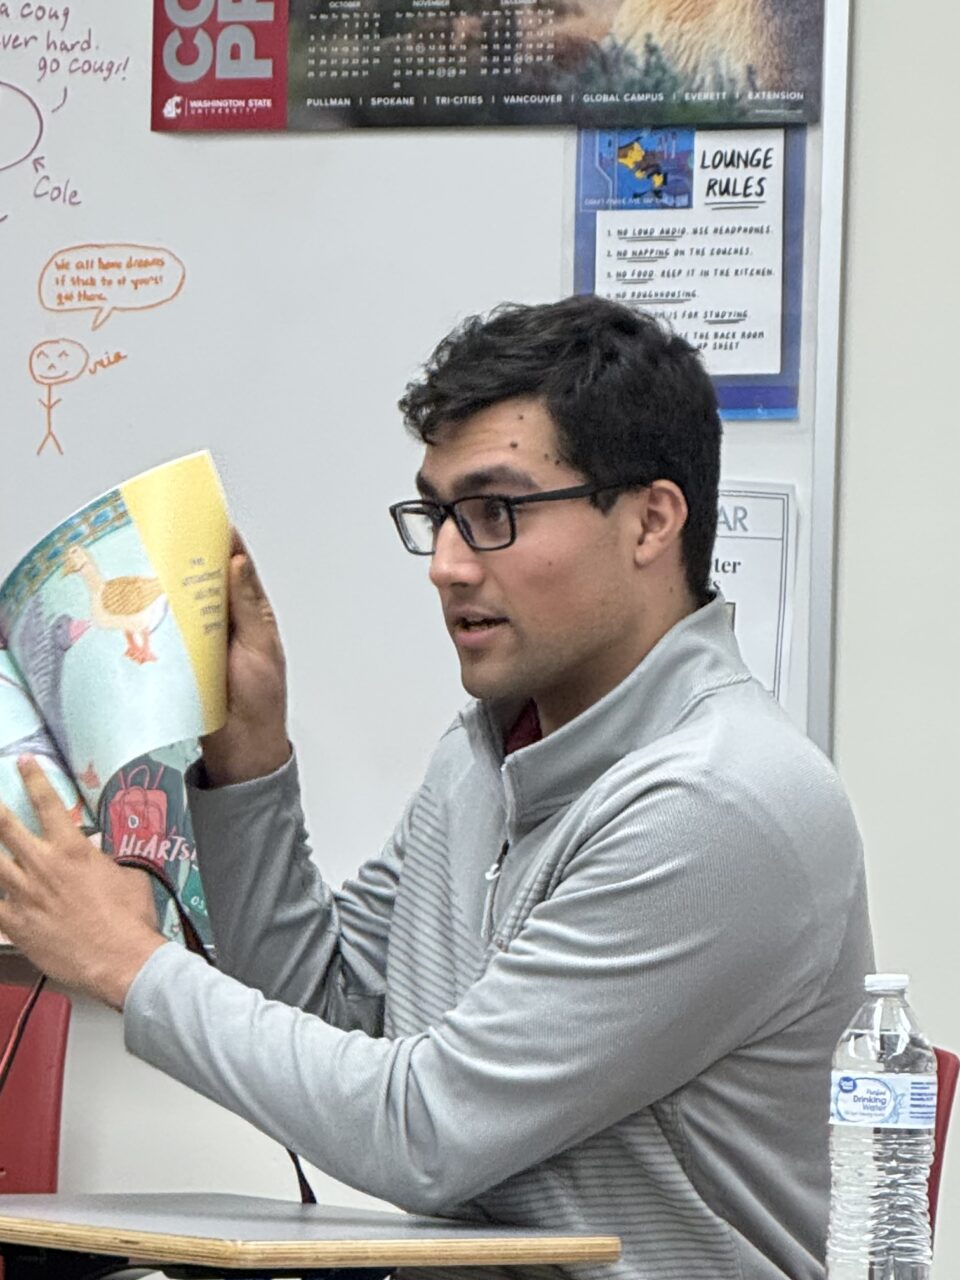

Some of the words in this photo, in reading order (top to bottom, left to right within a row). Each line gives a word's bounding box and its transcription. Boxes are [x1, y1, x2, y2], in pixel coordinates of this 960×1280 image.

[0, 3, 10, 18] a
[20, 1, 70, 32] coug
[46, 28, 99, 53] hard.
[38, 56, 60, 82] go
[189, 99, 246, 108] WASHINGTON
[248, 98, 273, 108] STATE
[306, 97, 351, 107] PULLMAN
[370, 96, 415, 106] SPOKANE
[435, 95, 484, 106] TRI-CITIES
[503, 94, 562, 104] VANCOUVER
[583, 93, 621, 103] GLOBAL
[623, 92, 664, 102] CAMPUS
[685, 91, 727, 101] EVERETT
[748, 90, 804, 100] EXTENSION
[699, 148, 775, 170] LOUNGE
[33, 176, 81, 206] Cole
[705, 176, 766, 198] RULES
[632, 228, 655, 237] LOUD
[692, 226, 709, 235] USE
[632, 248, 670, 257] NAPPING
[690, 247, 705, 256] THE
[75, 259, 94, 270] all
[616, 270, 628, 278] NO
[661, 269, 683, 278] KEEP
[686, 268, 696, 277] IT
[700, 269, 709, 278] IN
[714, 267, 730, 277] THE
[101, 275, 113, 286] to
[615, 291, 627, 299] NO
[681, 310, 699, 319] FOR
[694, 331, 710, 340] THE
[713, 331, 737, 340] BACK
[741, 331, 765, 339] ROOM
[712, 341, 740, 350] SHEET
[853, 1095, 887, 1106] Drinking
[862, 1104, 887, 1112] Water
